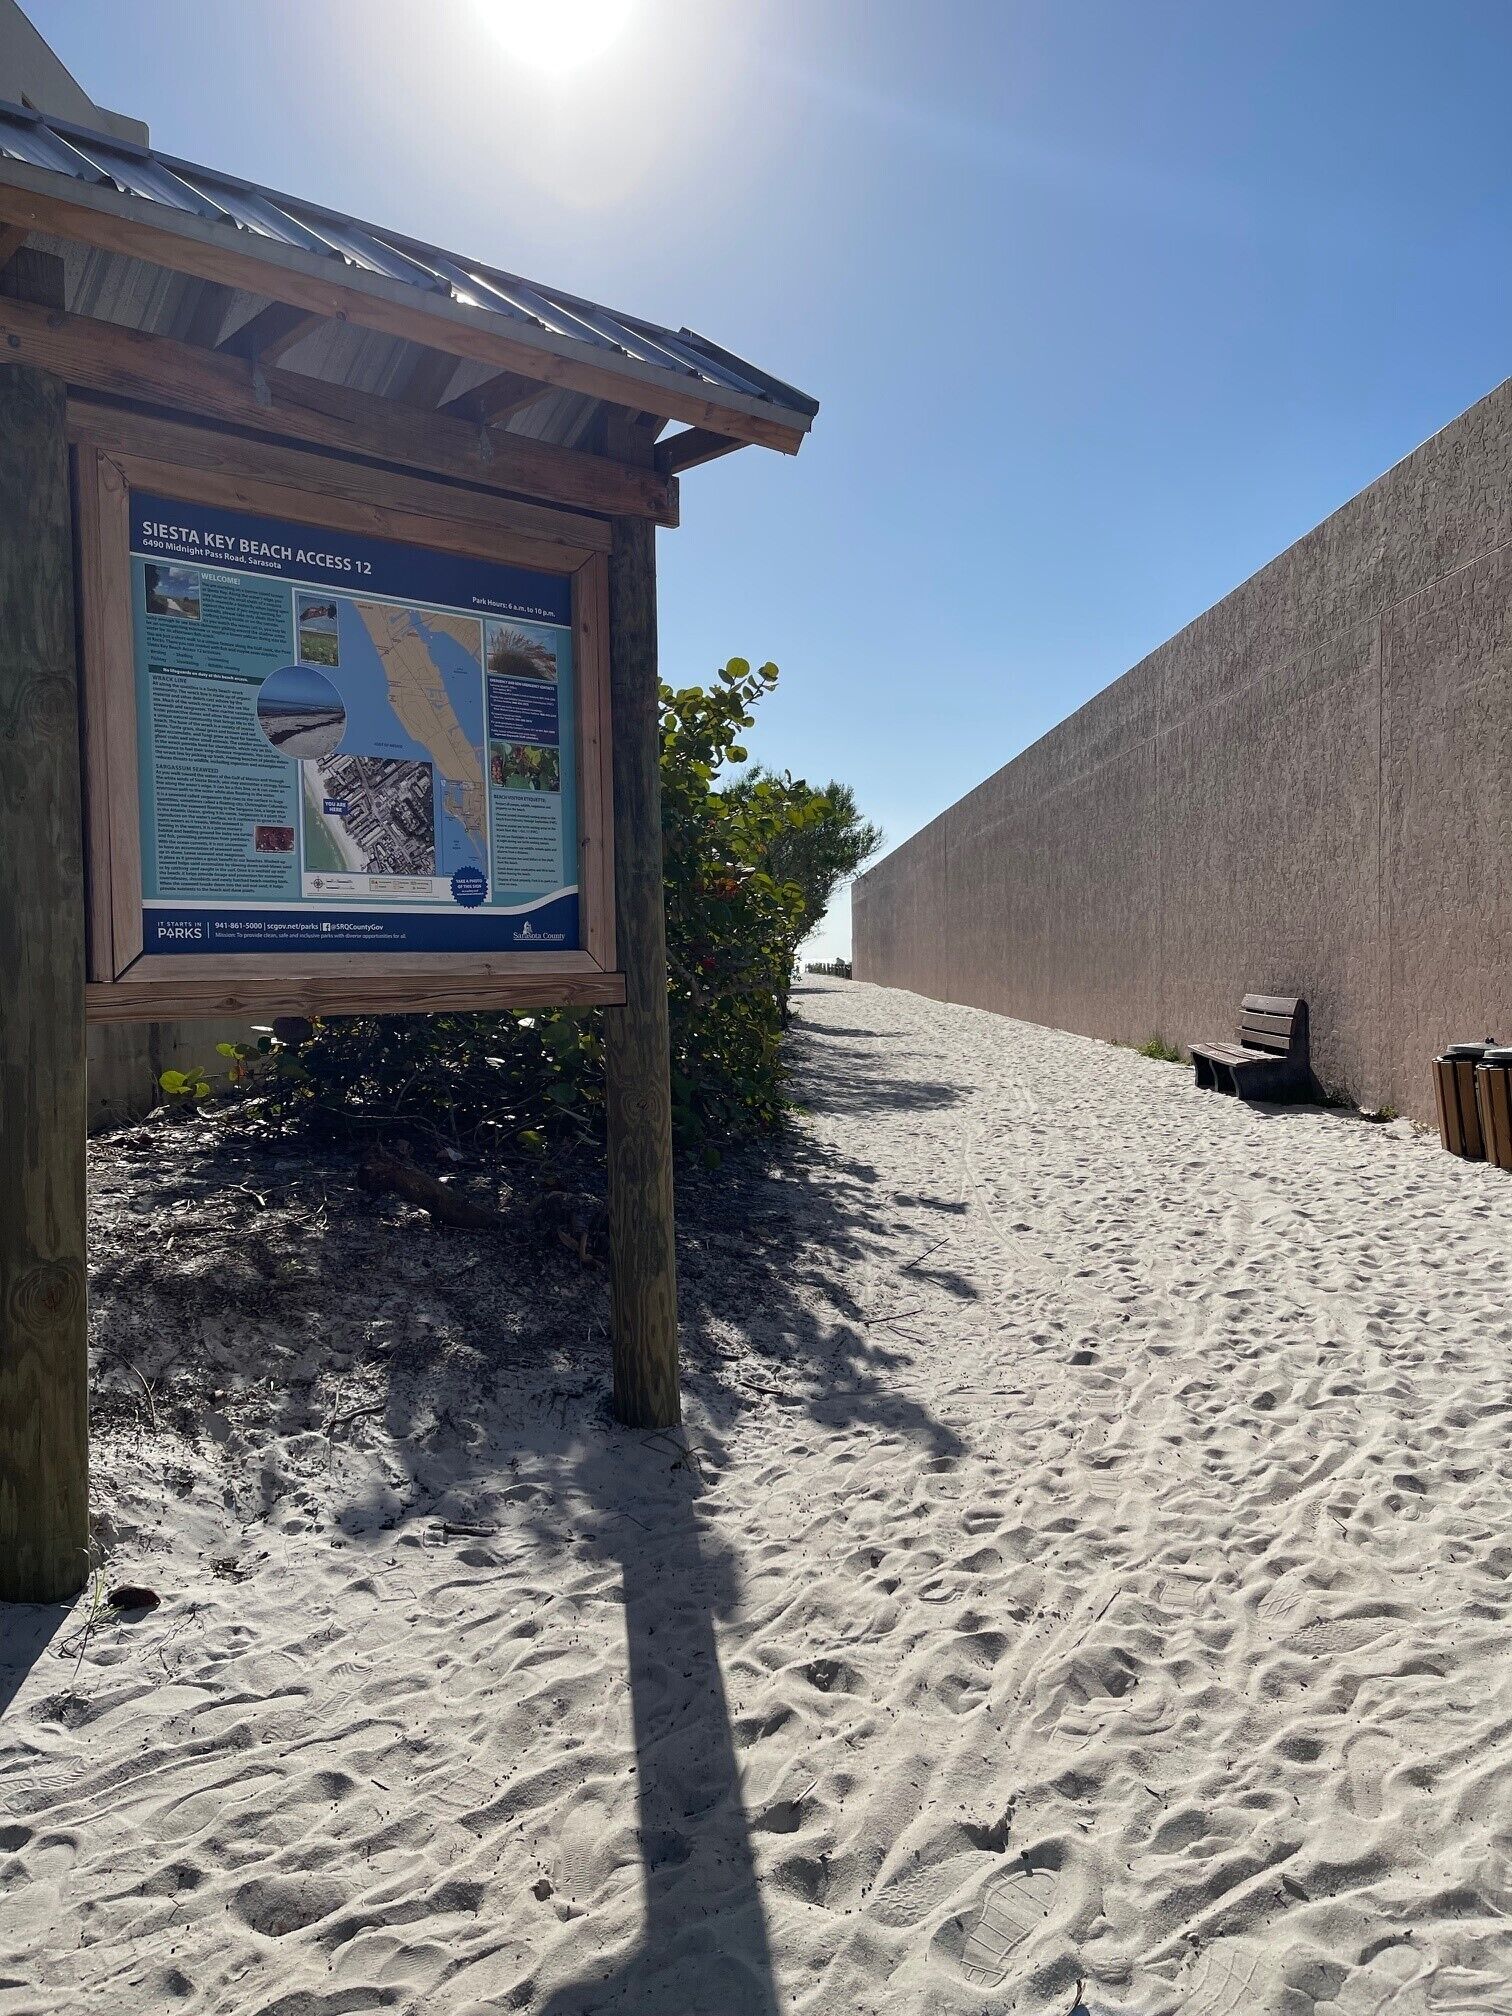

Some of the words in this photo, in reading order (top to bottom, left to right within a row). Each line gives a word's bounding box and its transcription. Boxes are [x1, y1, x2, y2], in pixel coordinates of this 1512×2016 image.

[142, 521, 200, 544] SIESTA
[204, 532, 235, 550] KEY
[239, 538, 292, 560] BEACH
[295, 549, 351, 571] ACCESS
[355, 560, 372, 575] 12
[142, 538, 164, 549] 6490
[165, 542, 204, 556] Midnight
[205, 549, 223, 559] Pass
[224, 552, 247, 564] Road,
[248, 557, 282, 569] Sarasota
[201, 572, 241, 585] WELCOME!
[472, 596, 487, 605] Park
[487, 599, 508, 609] Hours:
[158, 927, 202, 939] PARKS
[215, 922, 263, 930] 941-861-5000
[267, 922, 319, 931] scgov.net/parks
[513, 931, 542, 939] Sarasota
[542, 932, 566, 940] County
